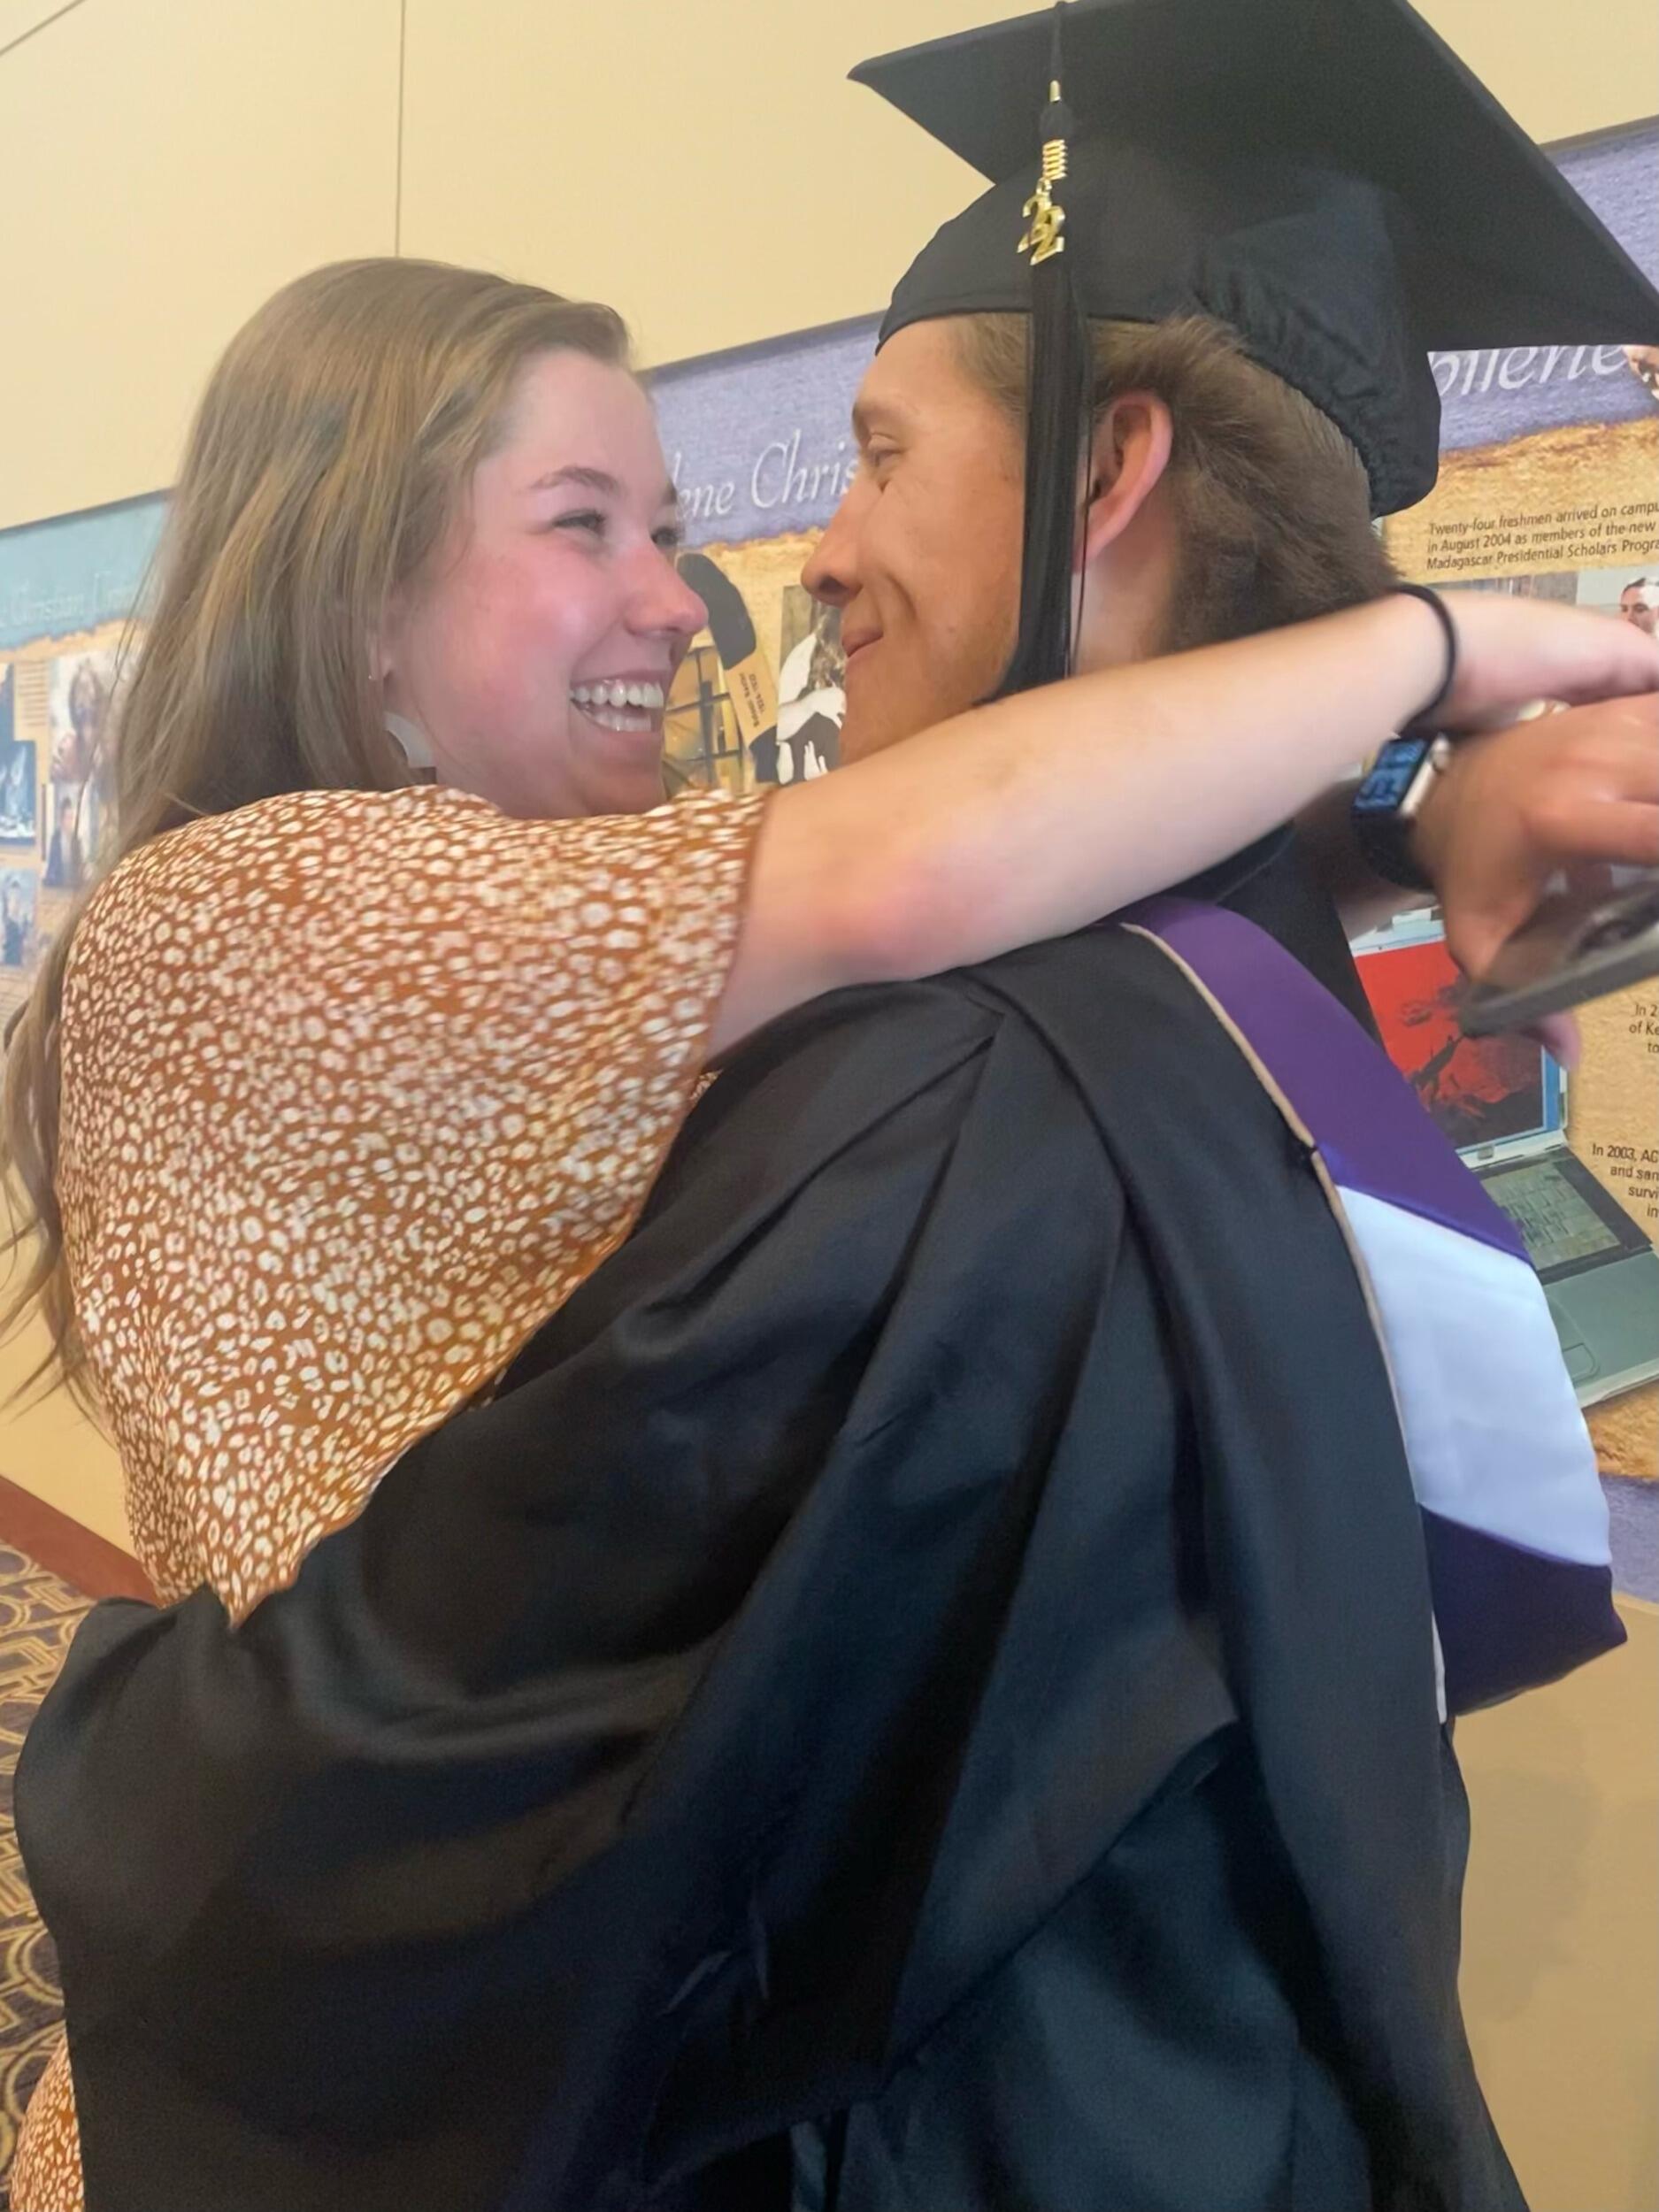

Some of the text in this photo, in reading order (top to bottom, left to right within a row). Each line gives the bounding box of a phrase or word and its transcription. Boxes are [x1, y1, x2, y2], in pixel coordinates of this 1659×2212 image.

[1429, 518, 1495, 536] Twenty-four
[1499, 512, 1552, 528] freshmen
[1555, 503, 1598, 523] arrived
[1601, 506, 1617, 518] on
[1427, 520, 1656, 554] in August 2004 as members of the new
[1426, 554, 1494, 571] Madagascar
[1497, 544, 1564, 564] Presidential
[1567, 541, 1617, 558] Scholars
[1634, 1002, 1647, 1017] In
[1629, 1020, 1643, 1034] of
[1593, 1142, 1604, 1156] In
[1607, 1144, 1637, 1163] 2003,
[1610, 1165, 1633, 1178] and
